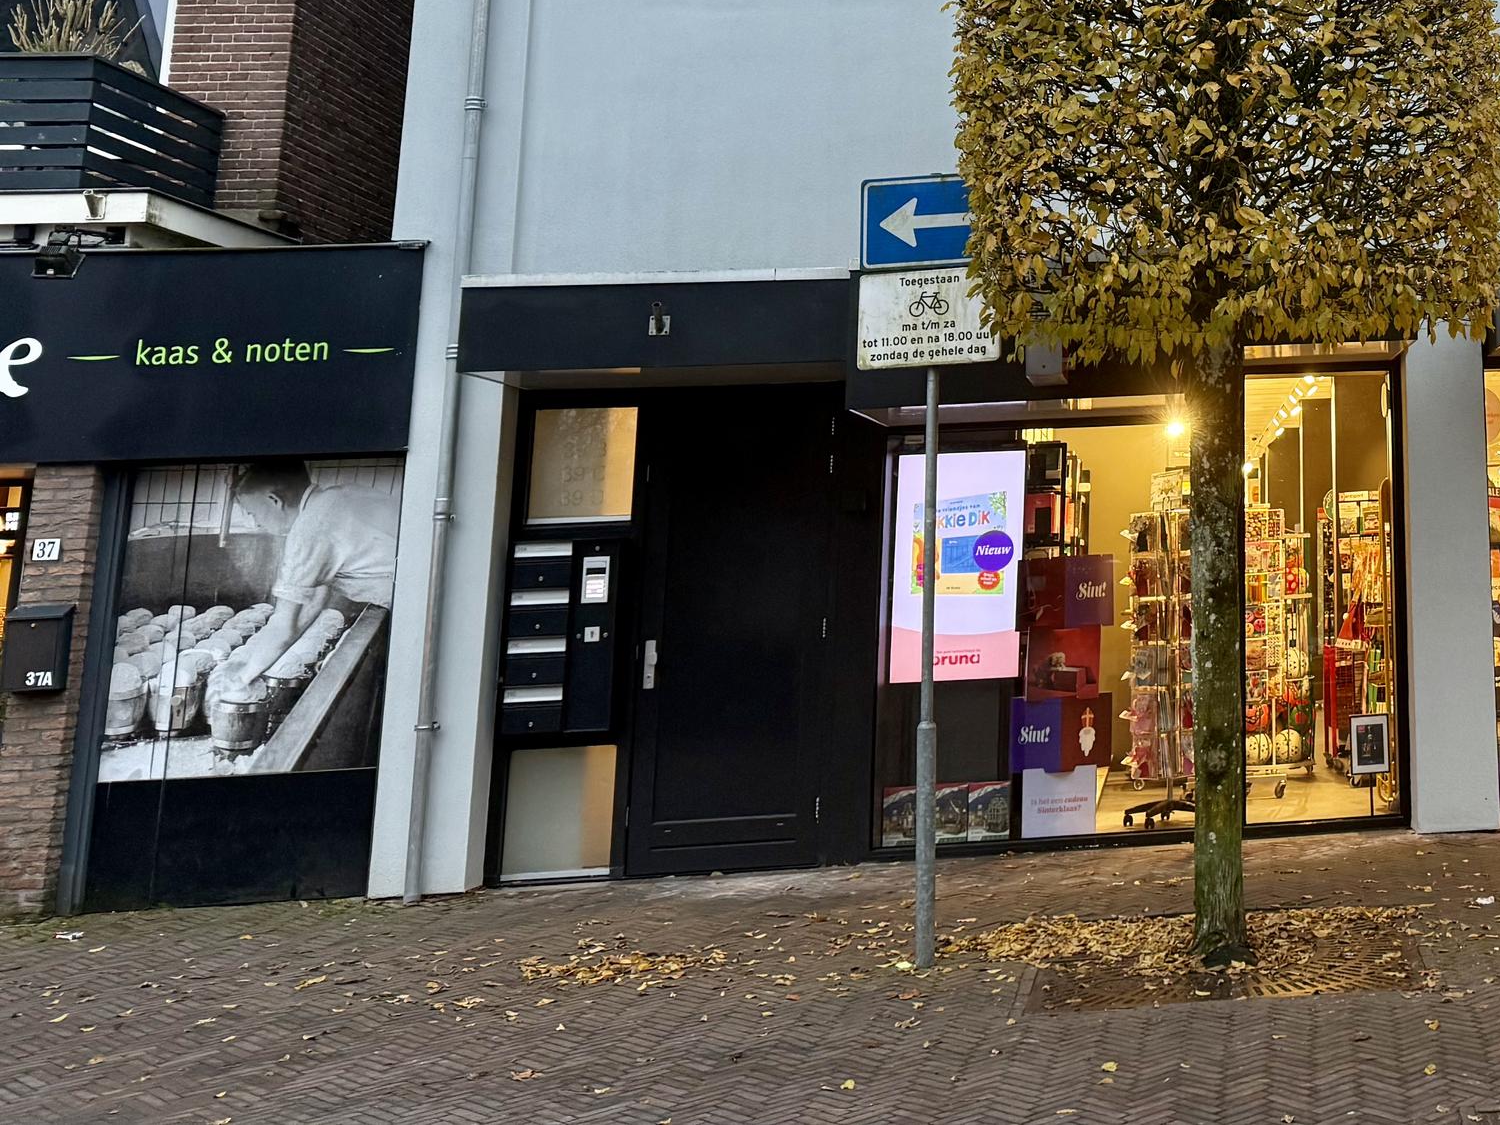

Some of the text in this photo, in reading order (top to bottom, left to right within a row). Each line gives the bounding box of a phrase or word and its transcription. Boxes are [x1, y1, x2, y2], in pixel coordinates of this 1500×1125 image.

[899, 275, 960, 288] Toegestaan
[902, 319, 956, 332] ma t/m za
[862, 338, 878, 348] tot
[881, 336, 907, 347] 11.00
[910, 336, 924, 345] en
[927, 334, 940, 344] na
[943, 331, 973, 342] 18.00
[135, 337, 329, 366] kaas & noten
[870, 345, 986, 362] zondag de gehele dag
[36, 541, 56, 559] 37
[975, 544, 1012, 557] Nieuw
[1075, 581, 1107, 600] Sint!
[25, 671, 52, 687] 37A
[1018, 725, 1051, 744] Sint!
